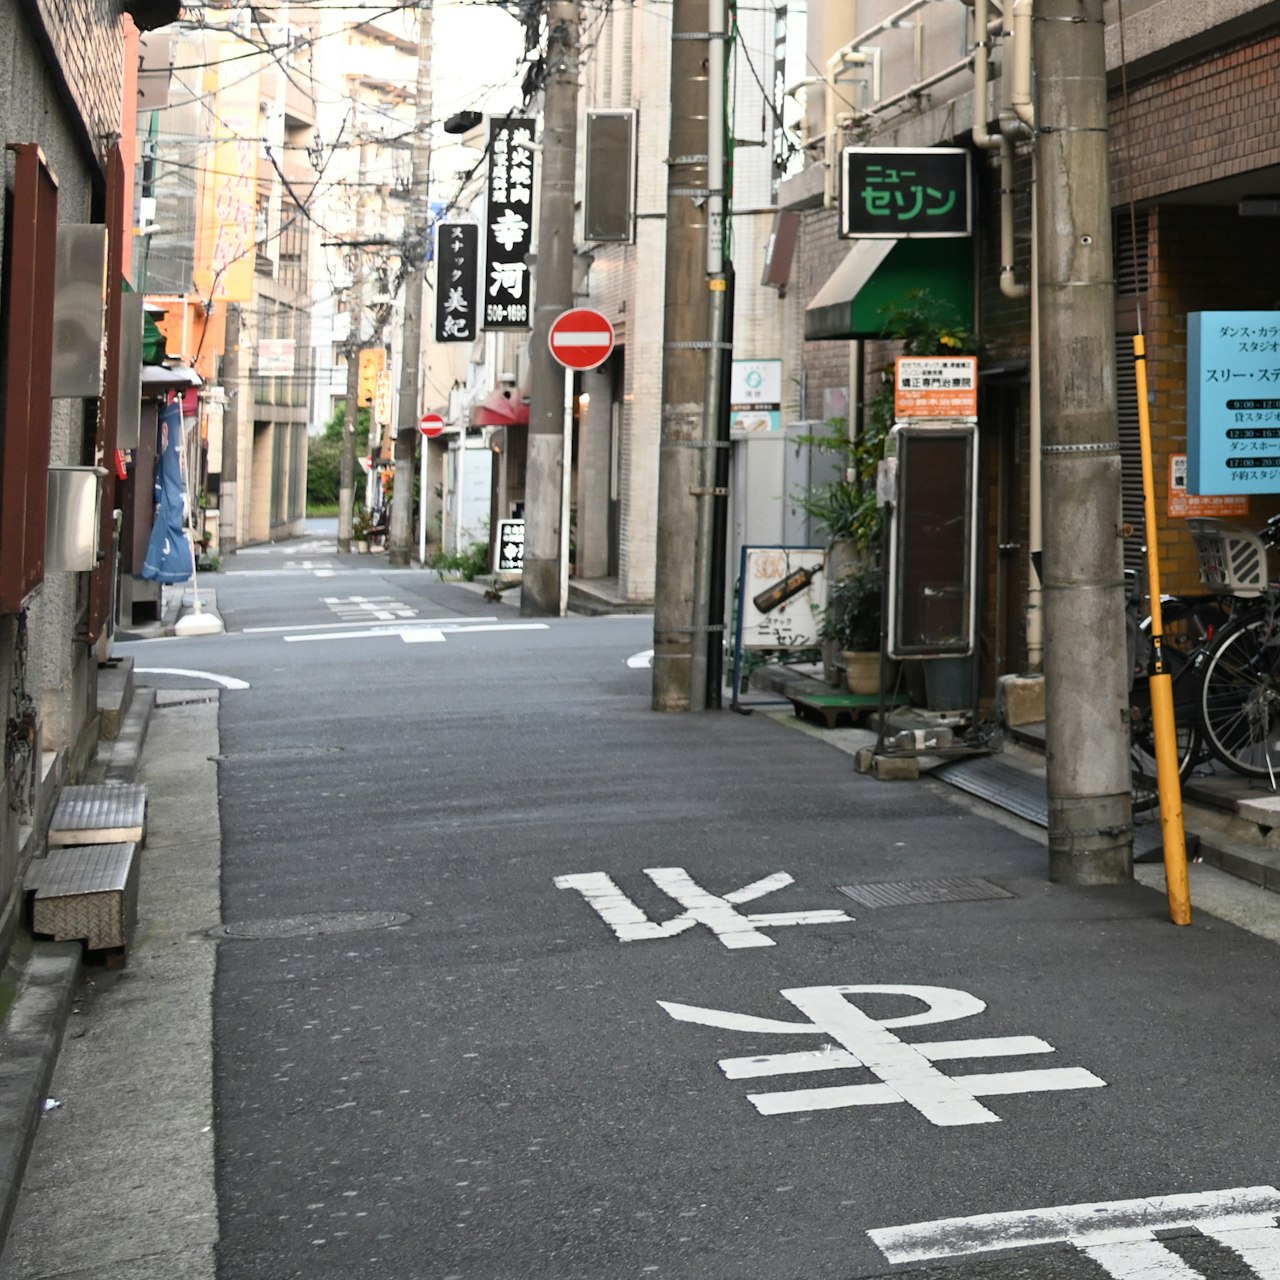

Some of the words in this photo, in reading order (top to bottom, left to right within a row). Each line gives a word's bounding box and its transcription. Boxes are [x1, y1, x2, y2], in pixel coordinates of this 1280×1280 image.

[865, 165, 916, 183] ニュー
[861, 186, 956, 220] セゾン
[1238, 341, 1280, 353] スタジオ
